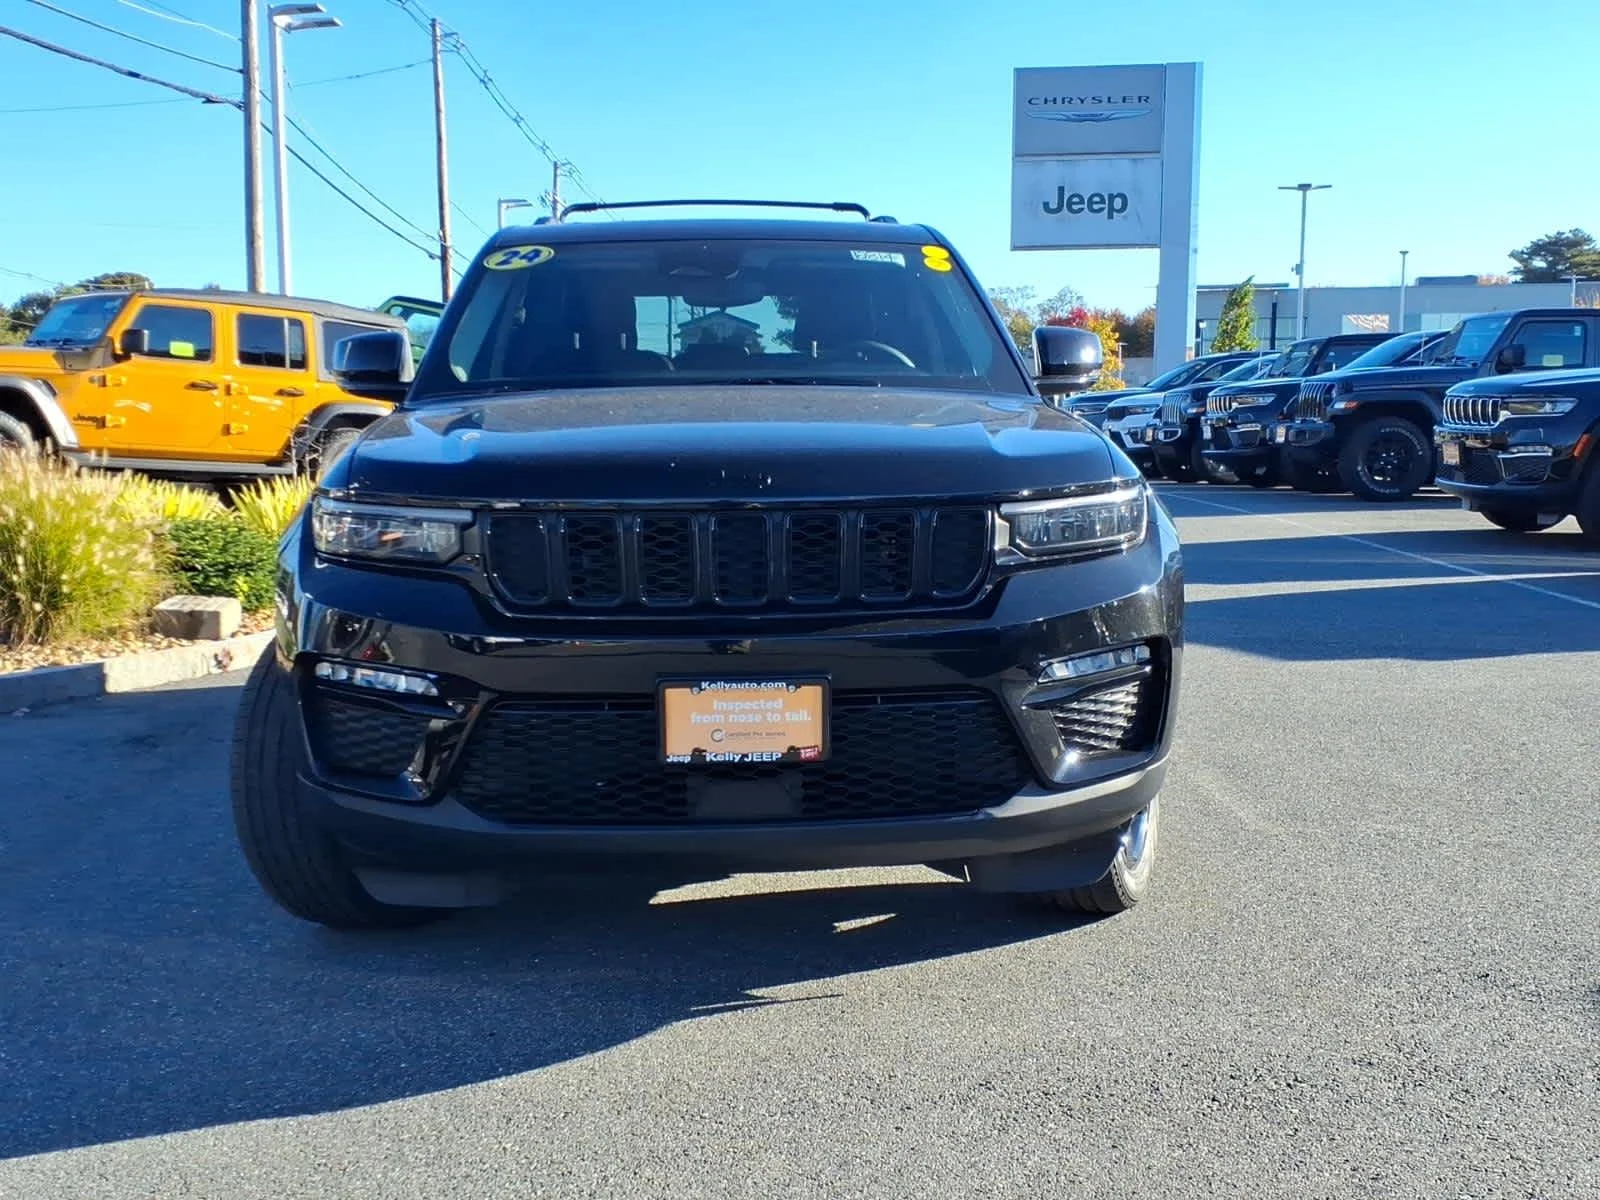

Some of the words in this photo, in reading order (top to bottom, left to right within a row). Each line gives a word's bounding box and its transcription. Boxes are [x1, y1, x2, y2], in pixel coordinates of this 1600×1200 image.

[1027, 95, 1152, 106] CHRYSLER
[1042, 185, 1129, 220] Jeep
[495, 248, 542, 266] 24
[701, 681, 787, 690] Kellyauto.com
[713, 698, 783, 711] Inspected
[691, 711, 725, 724] from
[728, 713, 762, 724] nose
[766, 711, 782, 723] to
[785, 708, 812, 722] tail.
[666, 754, 692, 764] Jeep
[705, 752, 741, 762] Kelly
[744, 751, 783, 762] JEEP
